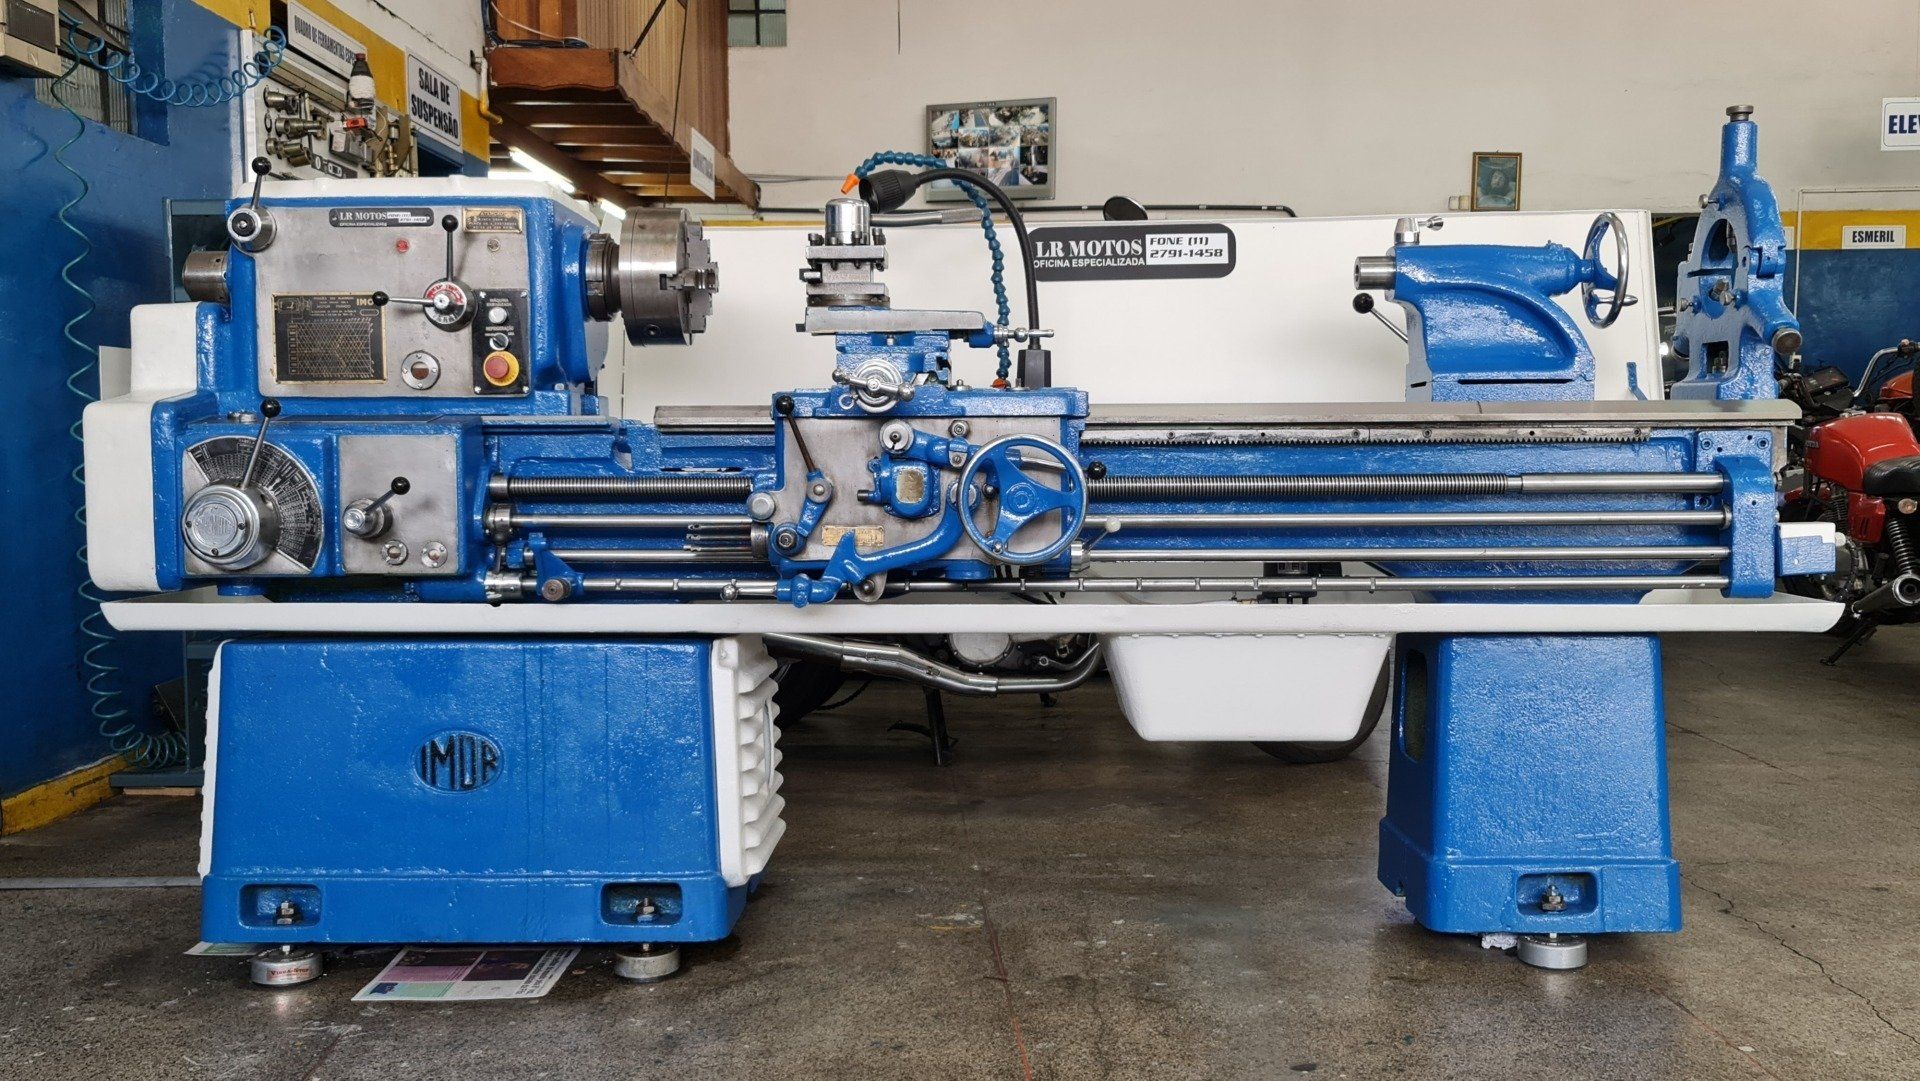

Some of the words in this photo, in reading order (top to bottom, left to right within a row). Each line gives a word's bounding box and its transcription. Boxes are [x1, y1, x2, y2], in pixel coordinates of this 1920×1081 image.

[418, 67, 440, 99] SALA
[440, 81, 450, 106] DE
[411, 93, 459, 139] SUSPENSÃO
[1888, 114, 1920, 134] ELE
[339, 212, 353, 220] LR
[355, 212, 387, 220] MOTOS
[1150, 237, 1183, 246] FONE
[1187, 236, 1209, 246] (11)
[1852, 230, 1895, 243] ESMERIL
[1036, 241, 1064, 257] LR
[1069, 238, 1143, 257] MOTOS
[1150, 248, 1223, 258] 2791-1458
[1034, 259, 1070, 268] OFICINA
[1072, 257, 1145, 267] ESPECIALIZADA
